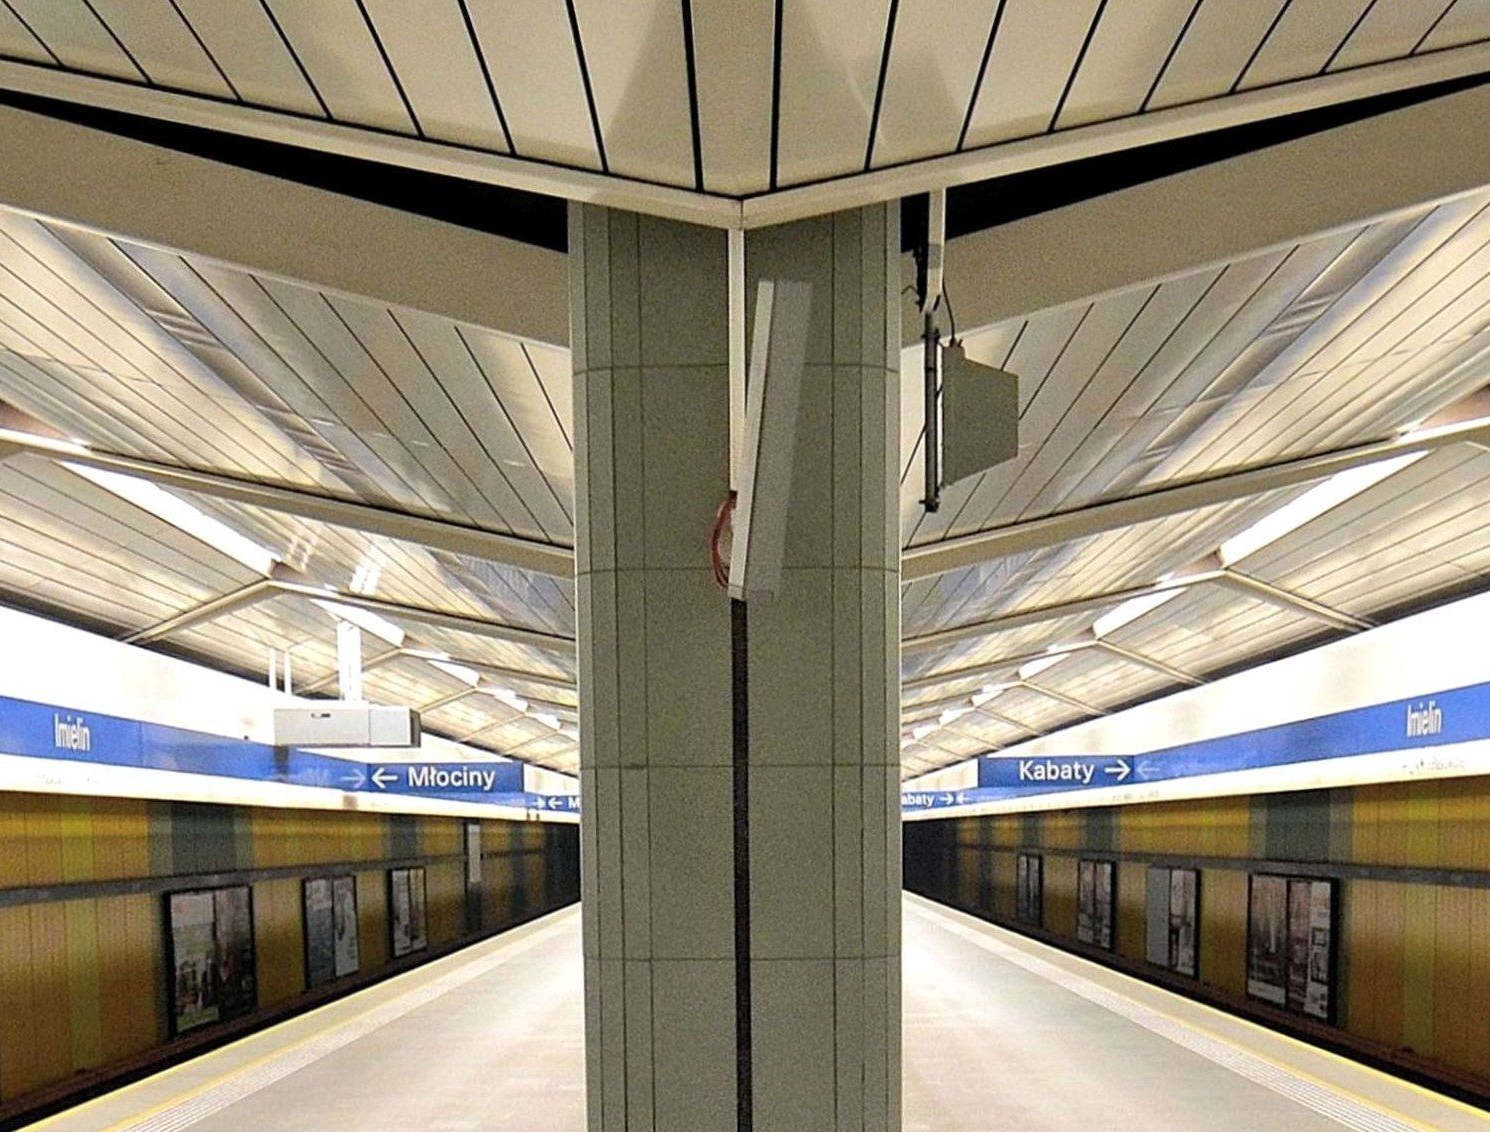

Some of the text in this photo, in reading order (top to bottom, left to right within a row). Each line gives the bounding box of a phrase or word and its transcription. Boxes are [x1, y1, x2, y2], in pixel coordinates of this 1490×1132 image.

[1406, 700, 1443, 738] Imielin
[54, 713, 90, 752] Imielin
[408, 766, 496, 791] Młociny
[1019, 759, 1095, 784] Kabaty
[901, 794, 935, 808] abaty
